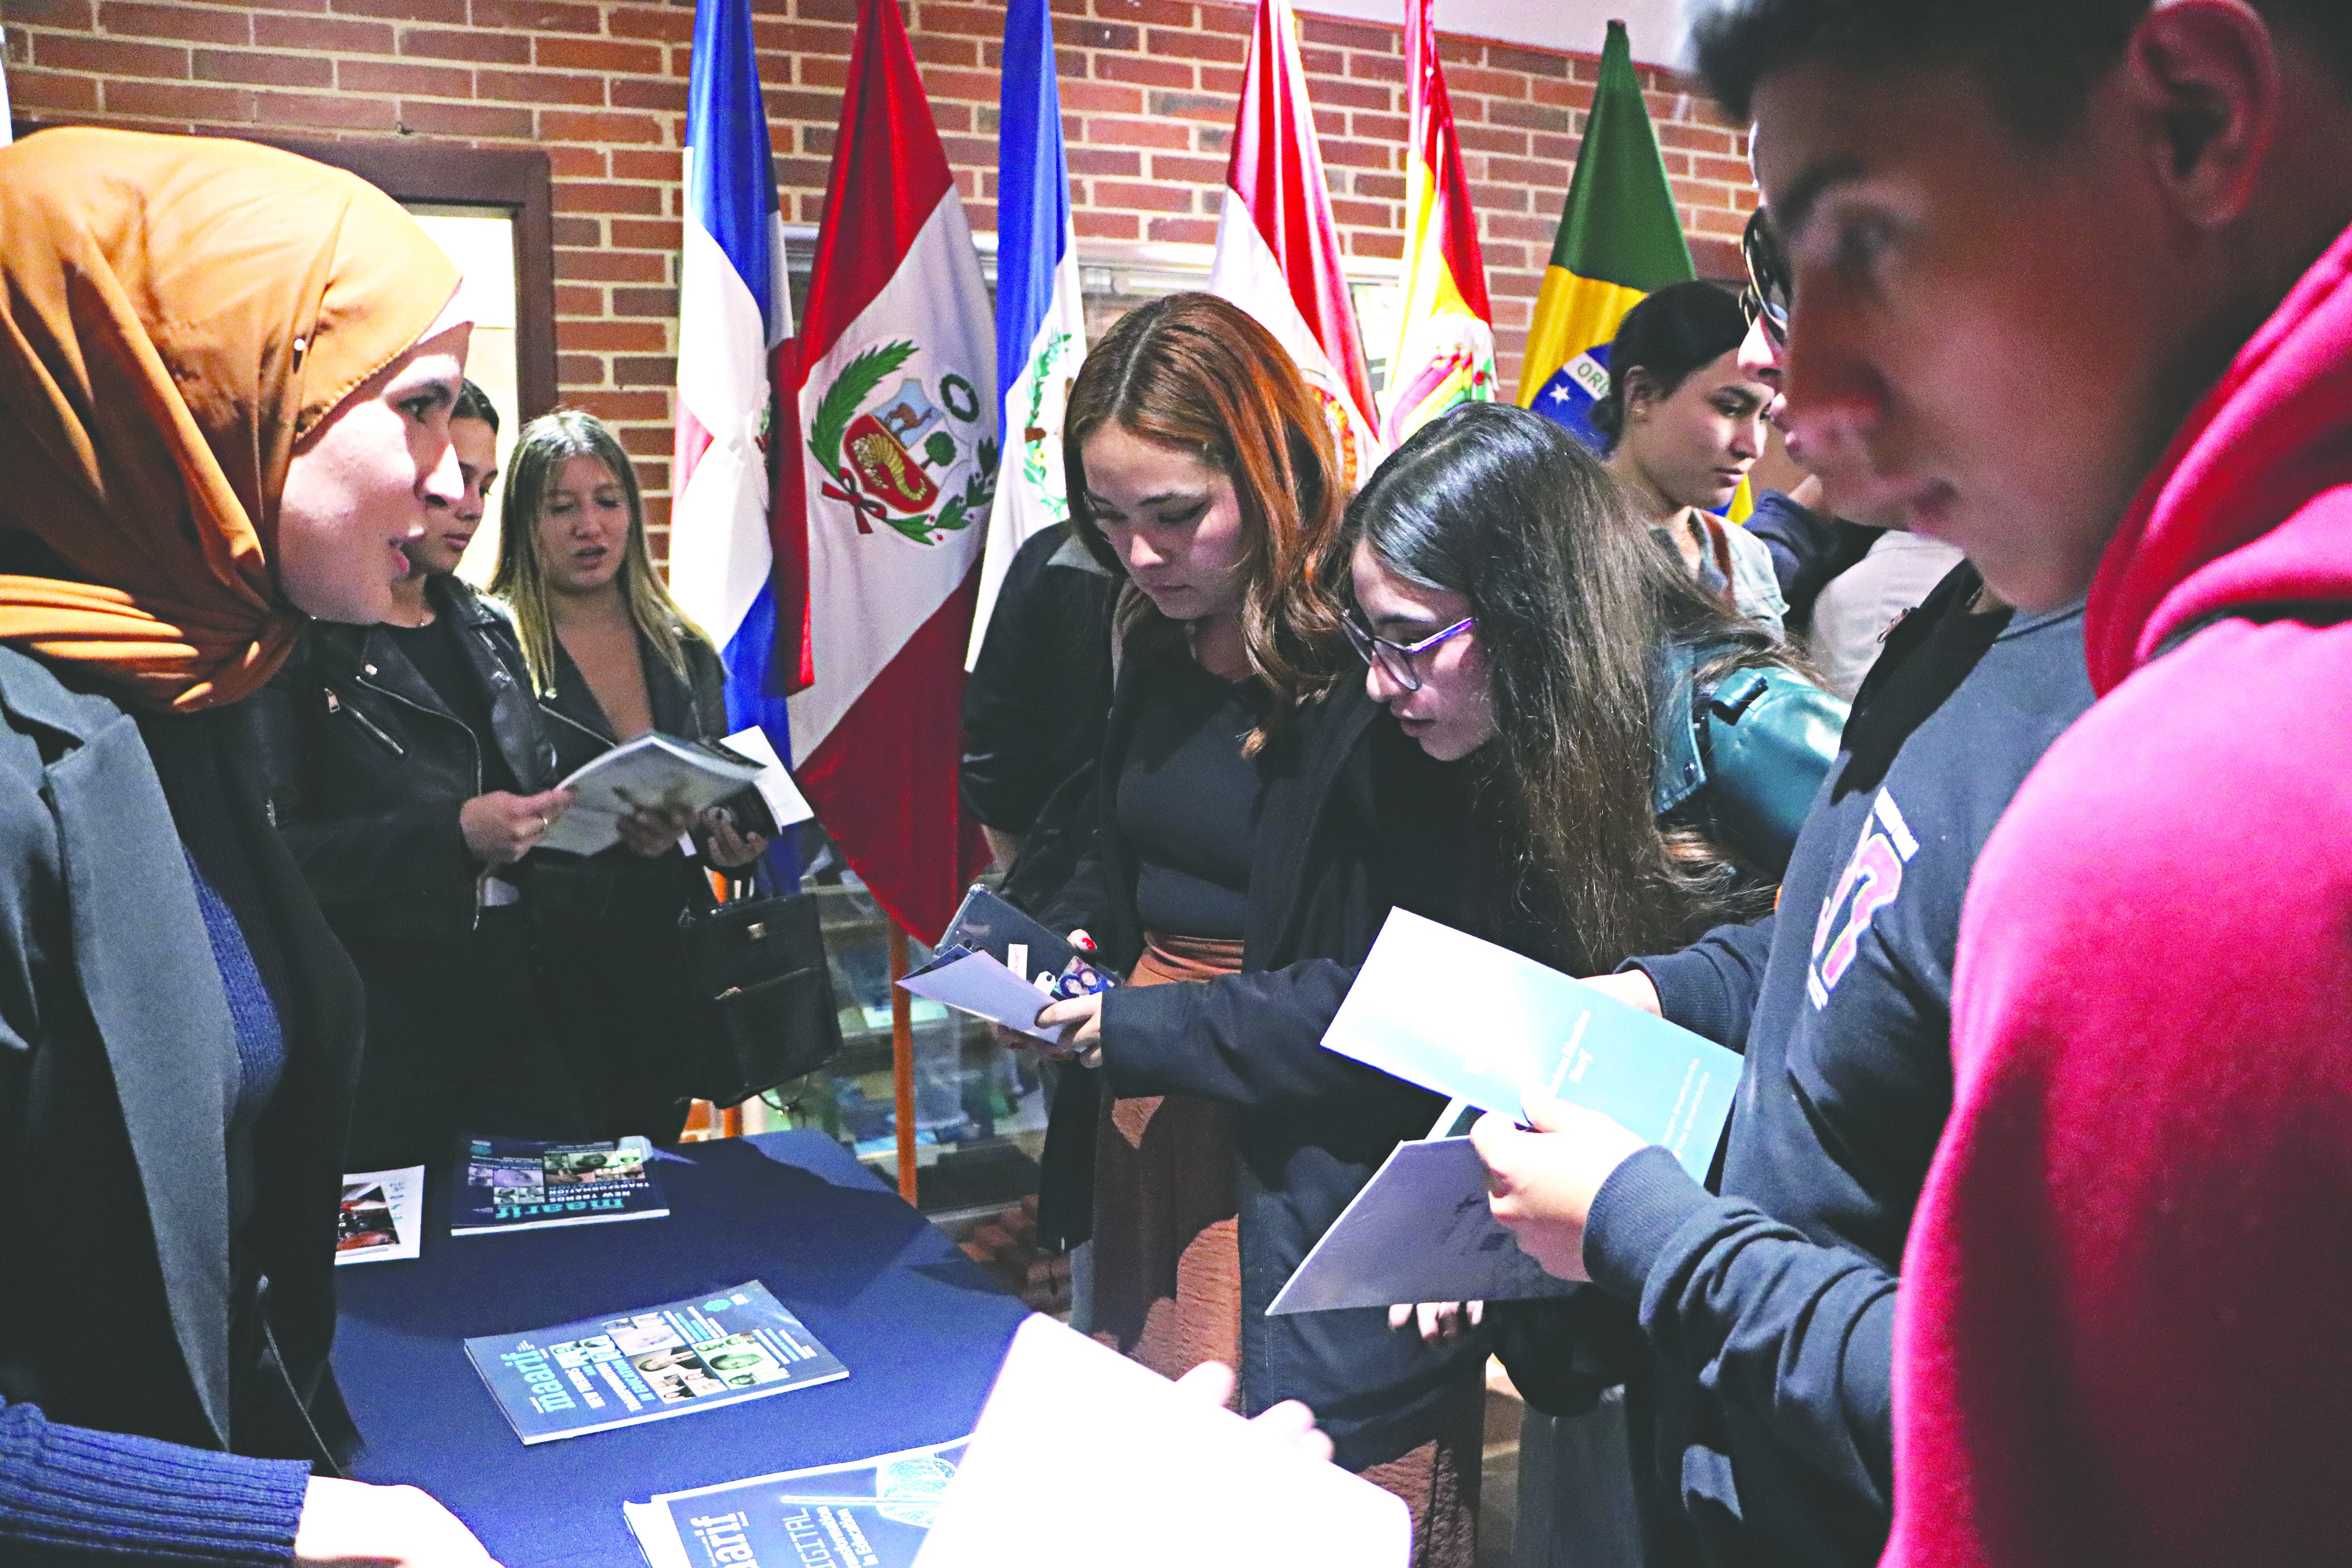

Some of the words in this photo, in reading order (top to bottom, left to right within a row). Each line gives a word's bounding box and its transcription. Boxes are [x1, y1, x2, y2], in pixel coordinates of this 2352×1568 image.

[548, 1182, 649, 1194] TRANSFORMATION
[548, 1193, 597, 1202] TRENDS
[494, 1198, 625, 1220] maarif
[499, 1347, 577, 1414] maarif
[564, 1367, 593, 1392] TRENDS
[595, 1361, 645, 1411] TRANSFORMATION
[610, 1358, 649, 1393] EDUCATION
[581, 1391, 606, 1408] NEW
[637, 1392, 656, 1401] IN
[836, 1508, 873, 1555] Education
[862, 1554, 878, 1566] in
